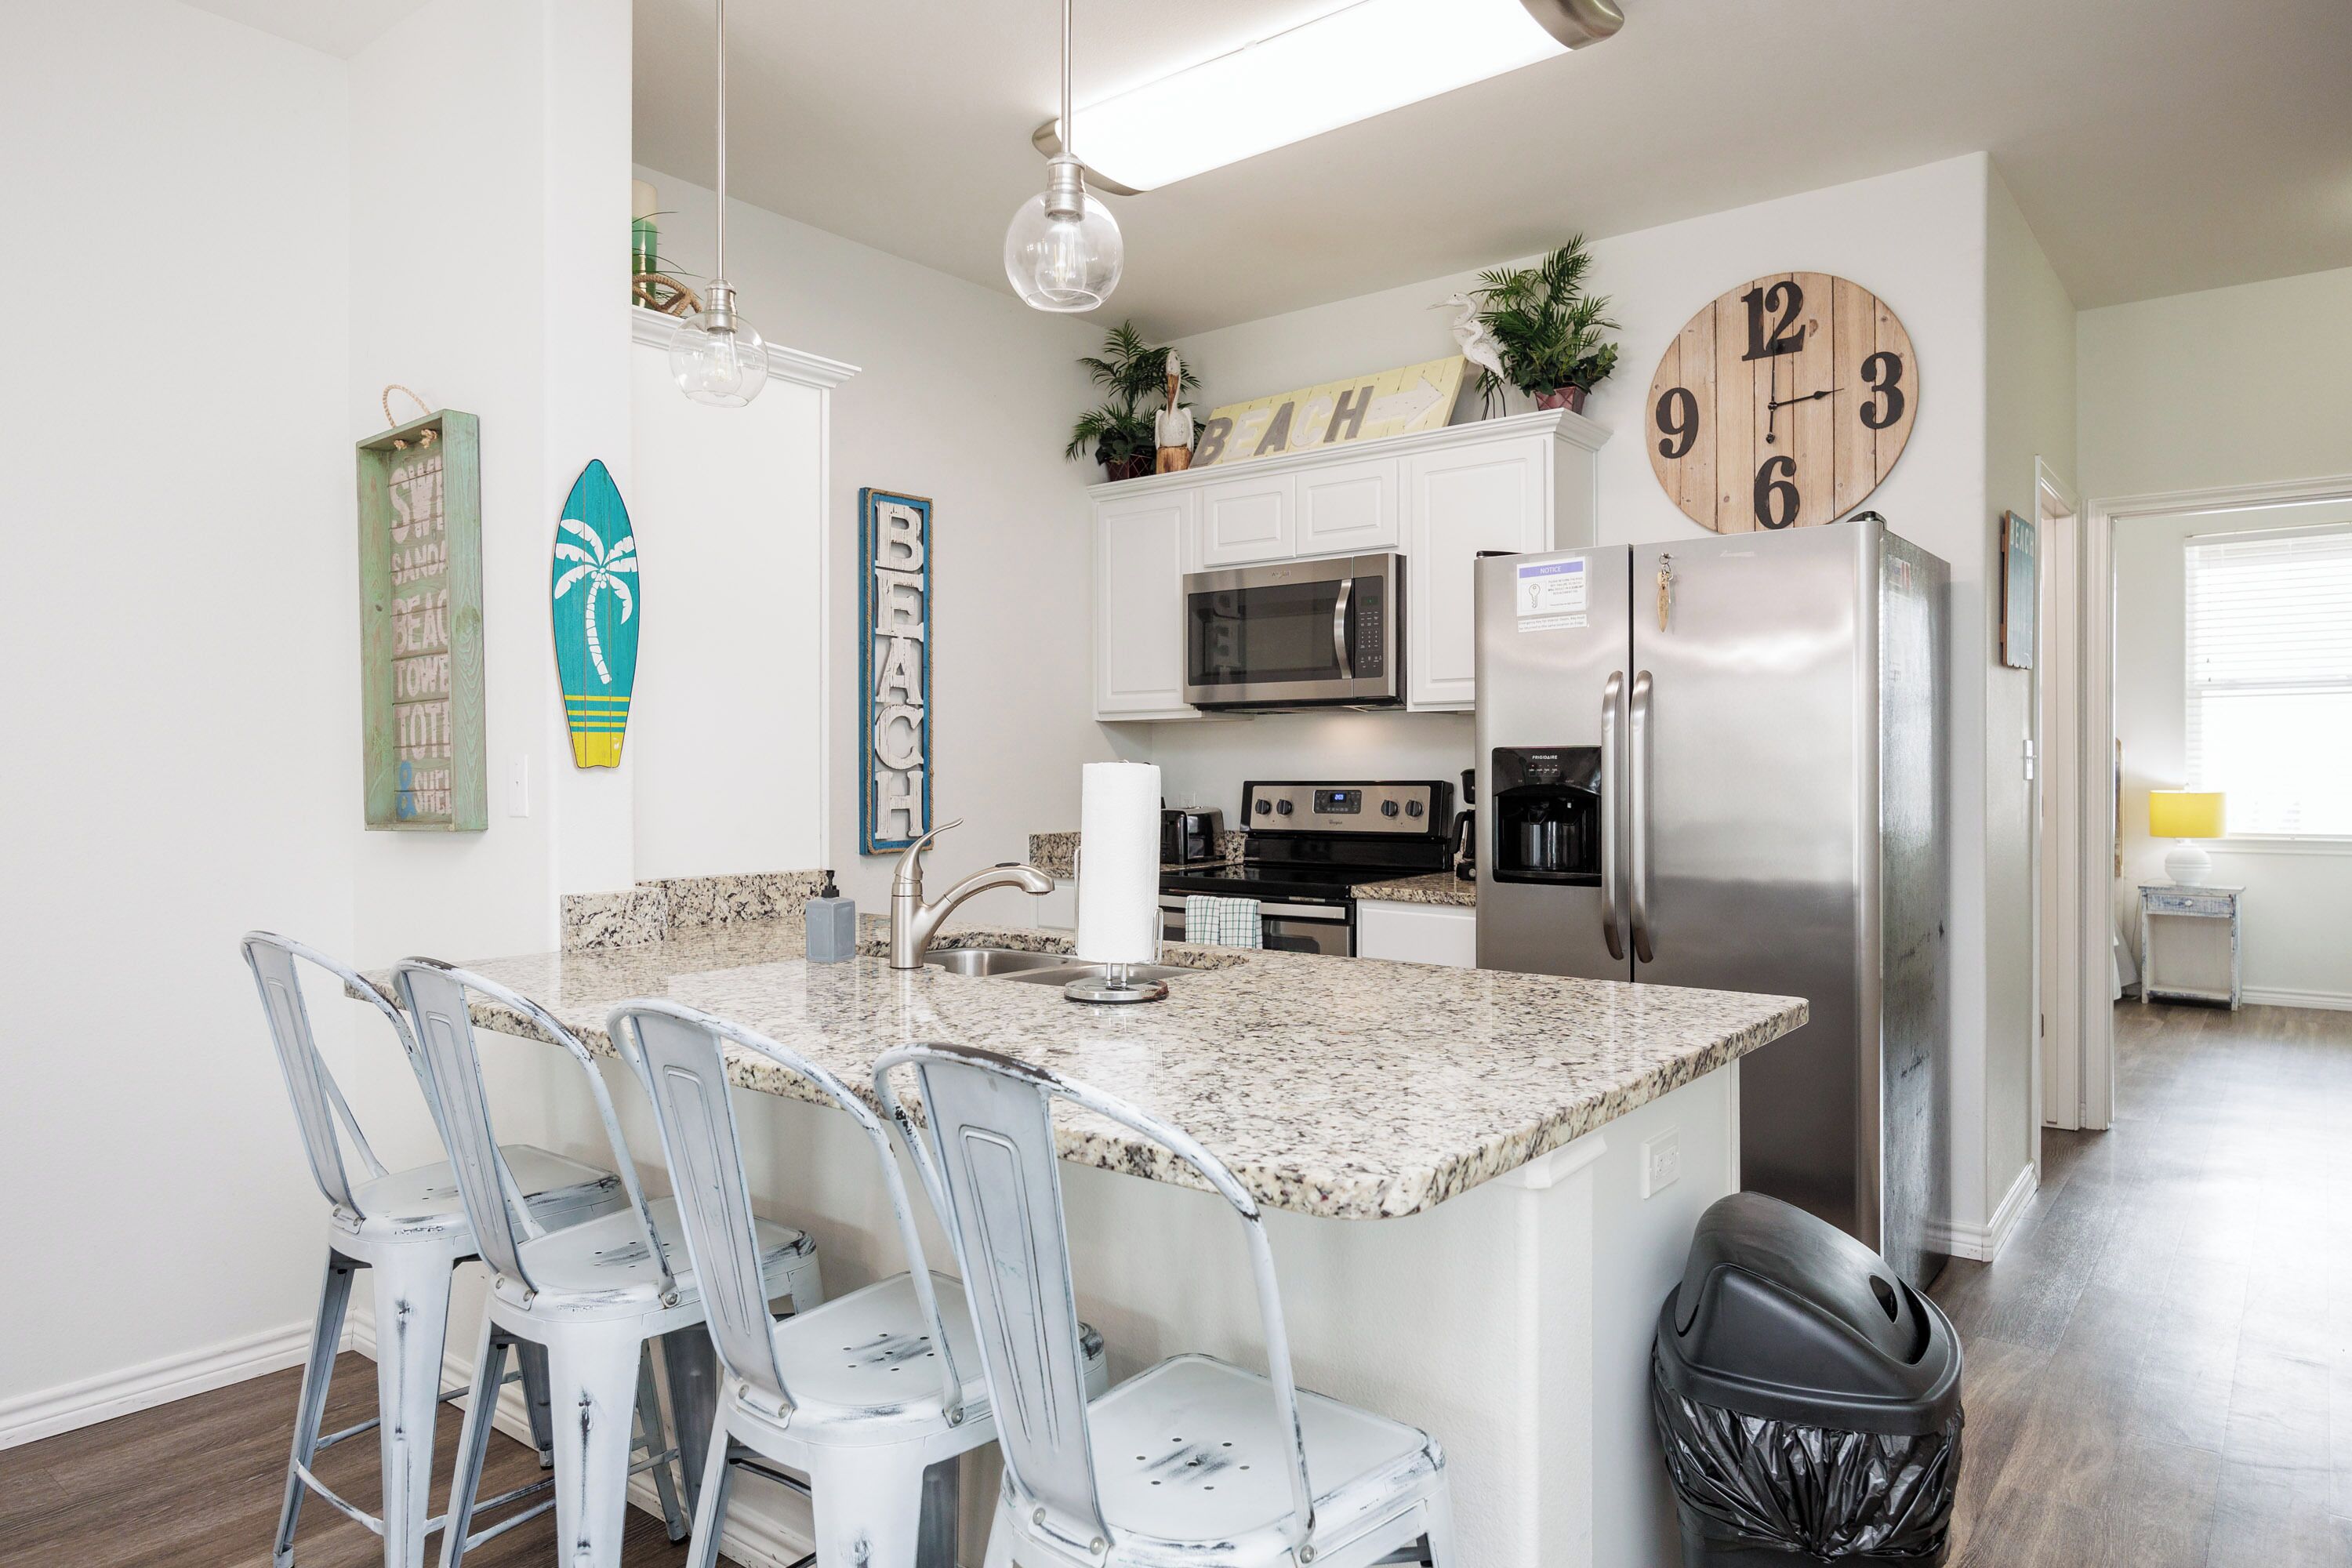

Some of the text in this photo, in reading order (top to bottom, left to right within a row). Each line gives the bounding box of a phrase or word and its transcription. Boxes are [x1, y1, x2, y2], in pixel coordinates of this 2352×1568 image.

[1740, 281, 1806, 361] 12
[1189, 386, 1374, 468] BEACH
[1656, 387, 1699, 459] 9
[1860, 351, 1904, 429] 3
[1753, 455, 1800, 530] 6
[2010, 517, 2034, 557] BEACH
[874, 500, 924, 839] BEACH
[397, 760, 416, 819] &
